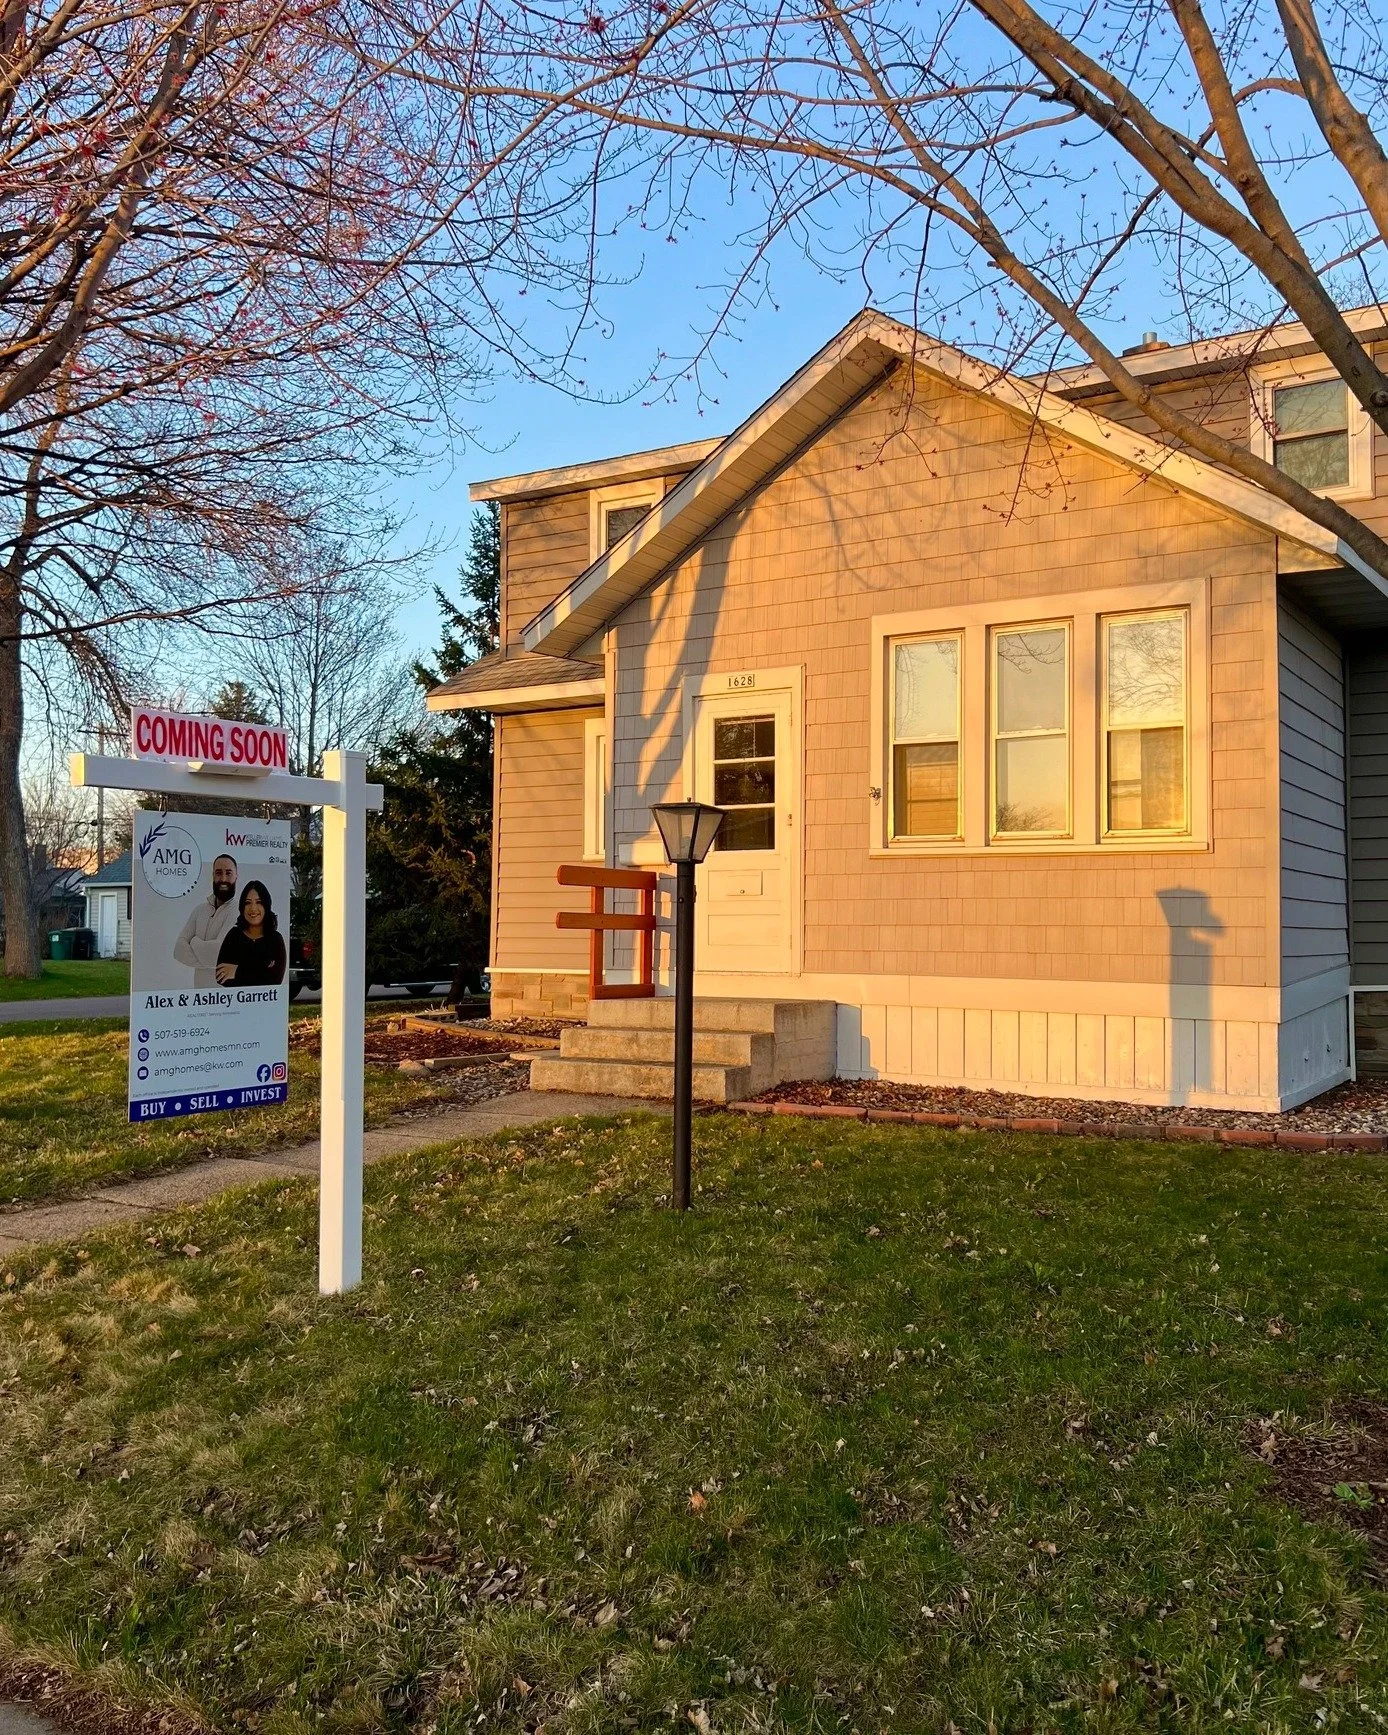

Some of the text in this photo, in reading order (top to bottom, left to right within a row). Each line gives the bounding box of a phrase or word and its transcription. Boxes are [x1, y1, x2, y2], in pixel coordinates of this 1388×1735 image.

[728, 675, 753, 687] 1628
[136, 713, 286, 768] COMING SOON
[225, 828, 247, 846] kw
[246, 840, 289, 849] PREMIER REALTY
[152, 848, 192, 865] AMG
[155, 867, 188, 877] HOMES
[144, 988, 278, 1009] Alex & Ashley Garrett
[154, 1027, 210, 1040] 507-519-6924
[155, 1041, 260, 1058] www.amghomesmn.com
[154, 1059, 244, 1077] amghomes@kw.com
[140, 1086, 281, 1117] BUY SELL INVEST
